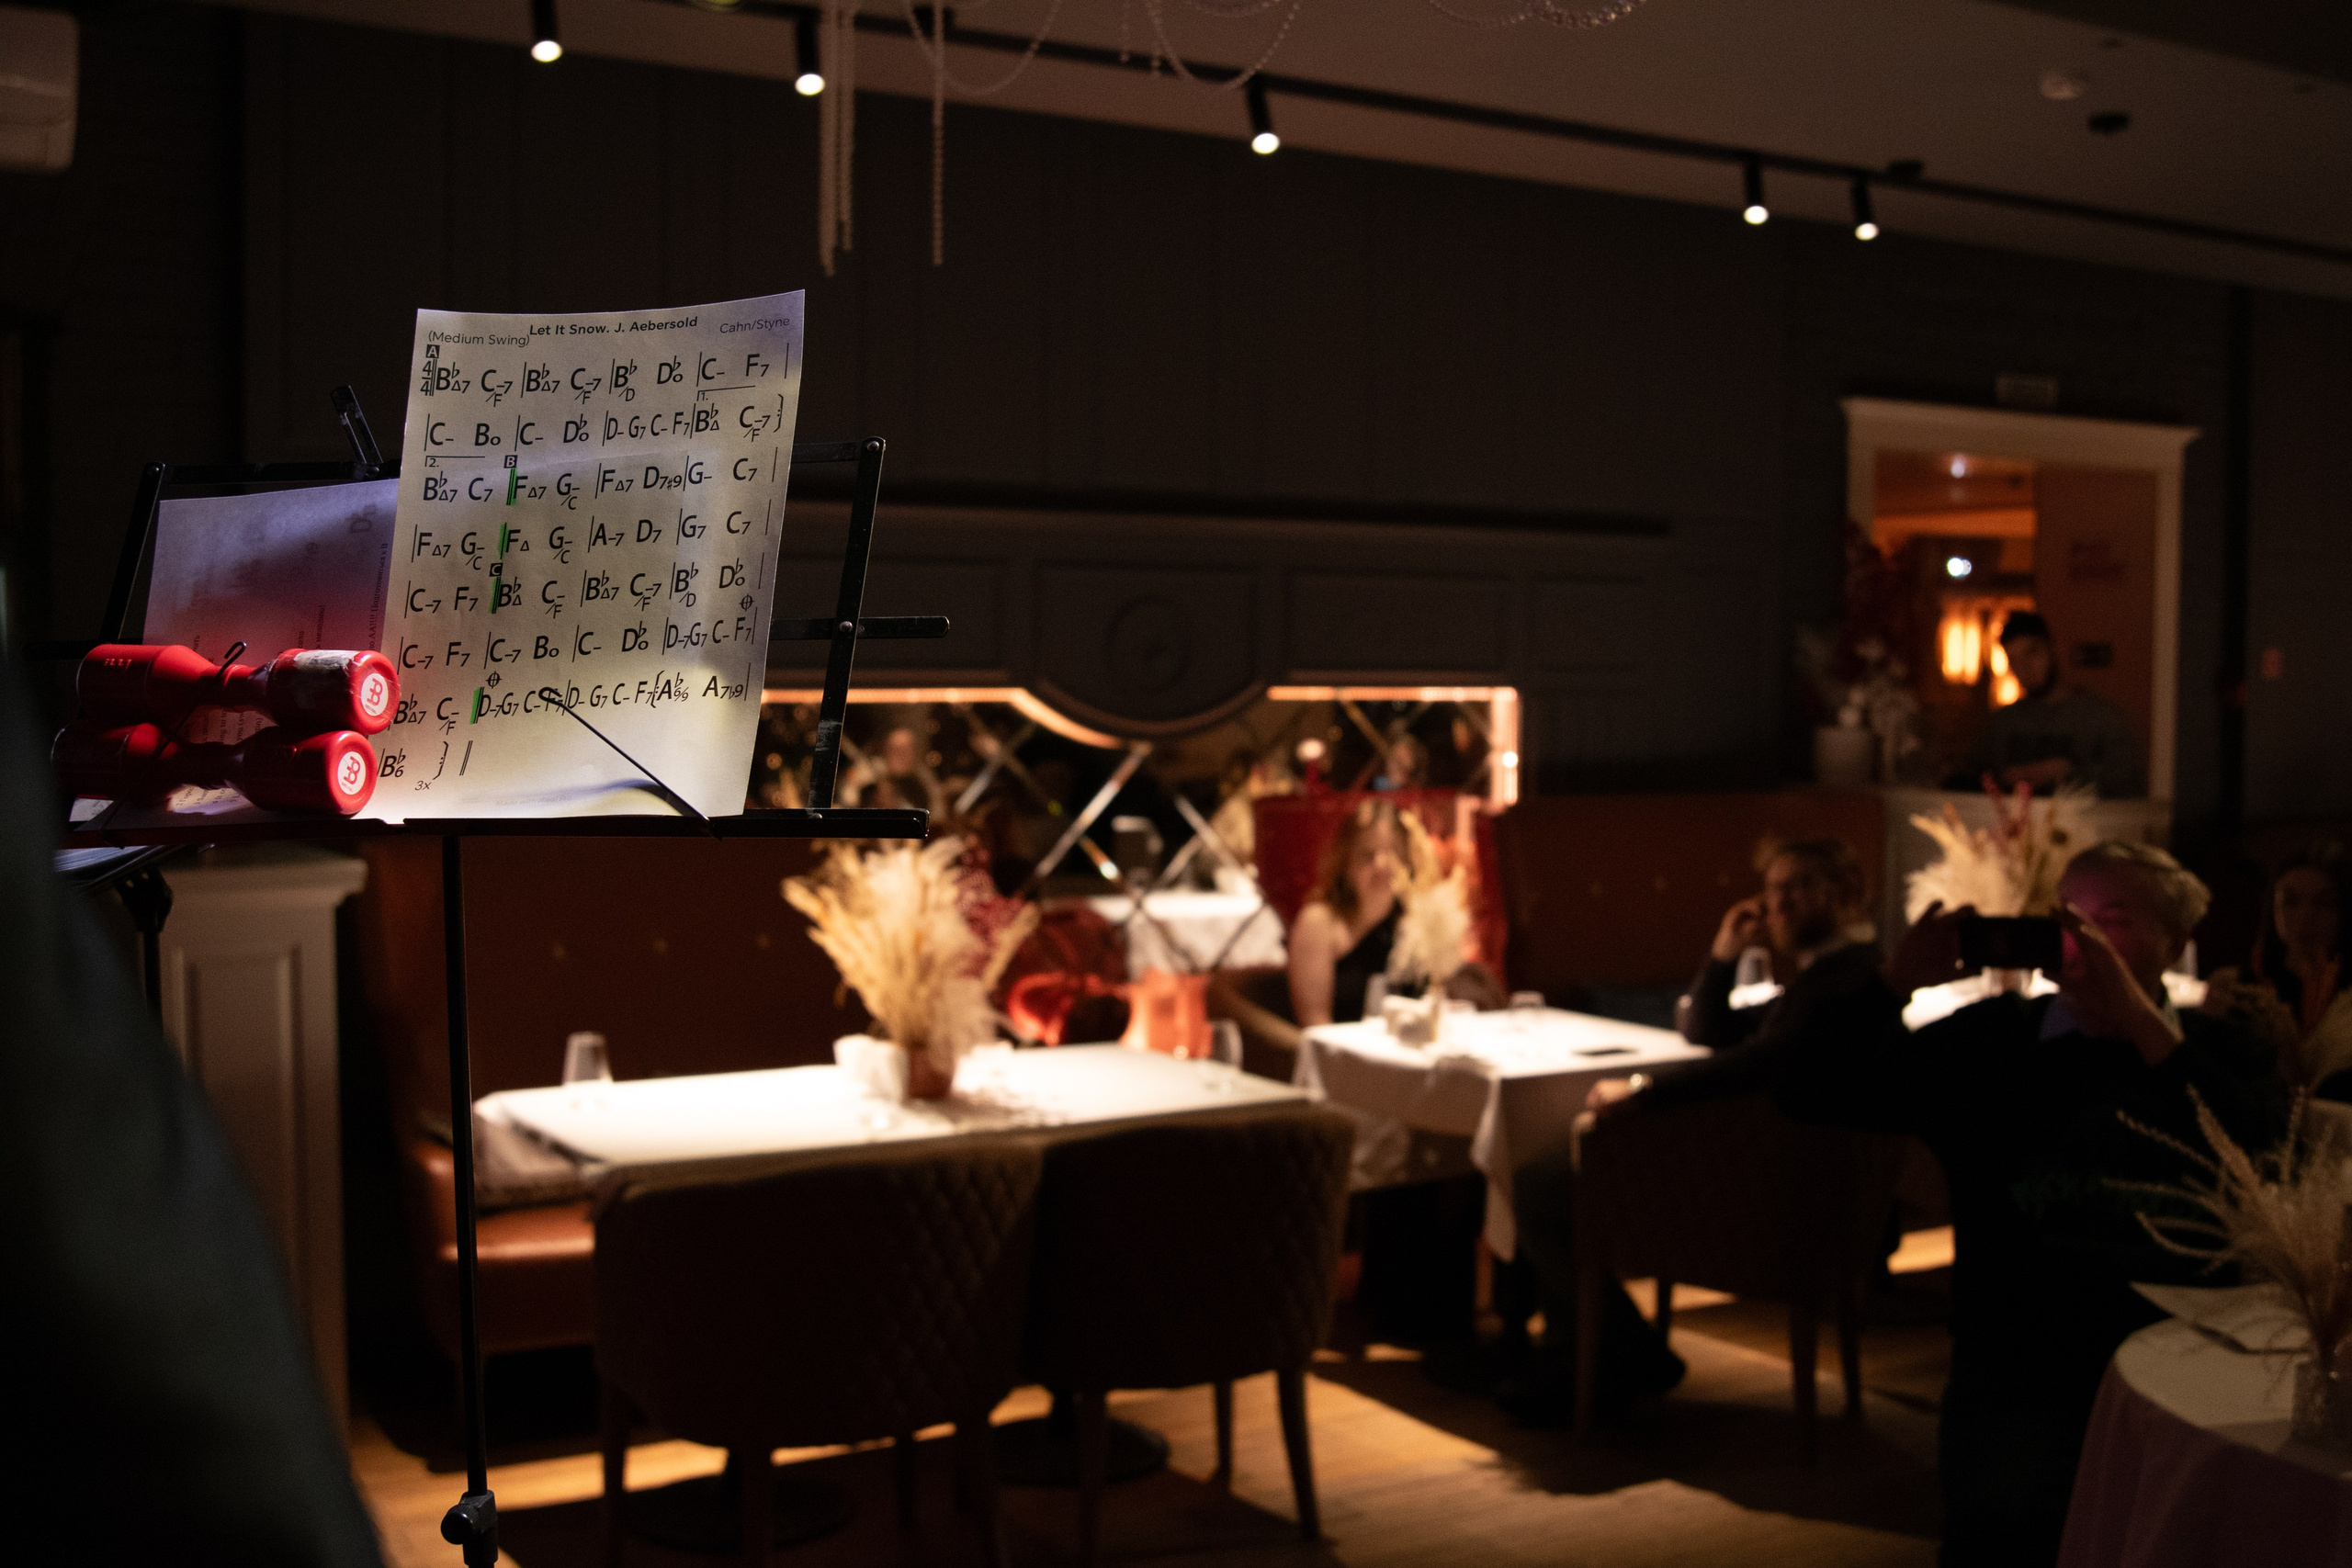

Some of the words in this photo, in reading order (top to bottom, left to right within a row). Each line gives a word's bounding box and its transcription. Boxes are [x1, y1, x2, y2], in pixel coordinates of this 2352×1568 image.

[529, 324, 551, 335] Let
[555, 324, 565, 334] It
[570, 324, 610, 334] Snow.
[614, 322, 625, 333] J.
[629, 316, 698, 332] Aebersold
[719, 318, 790, 334] Cahn/Styne
[428, 330, 484, 344] (Medium
[489, 333, 530, 348] Swing)
